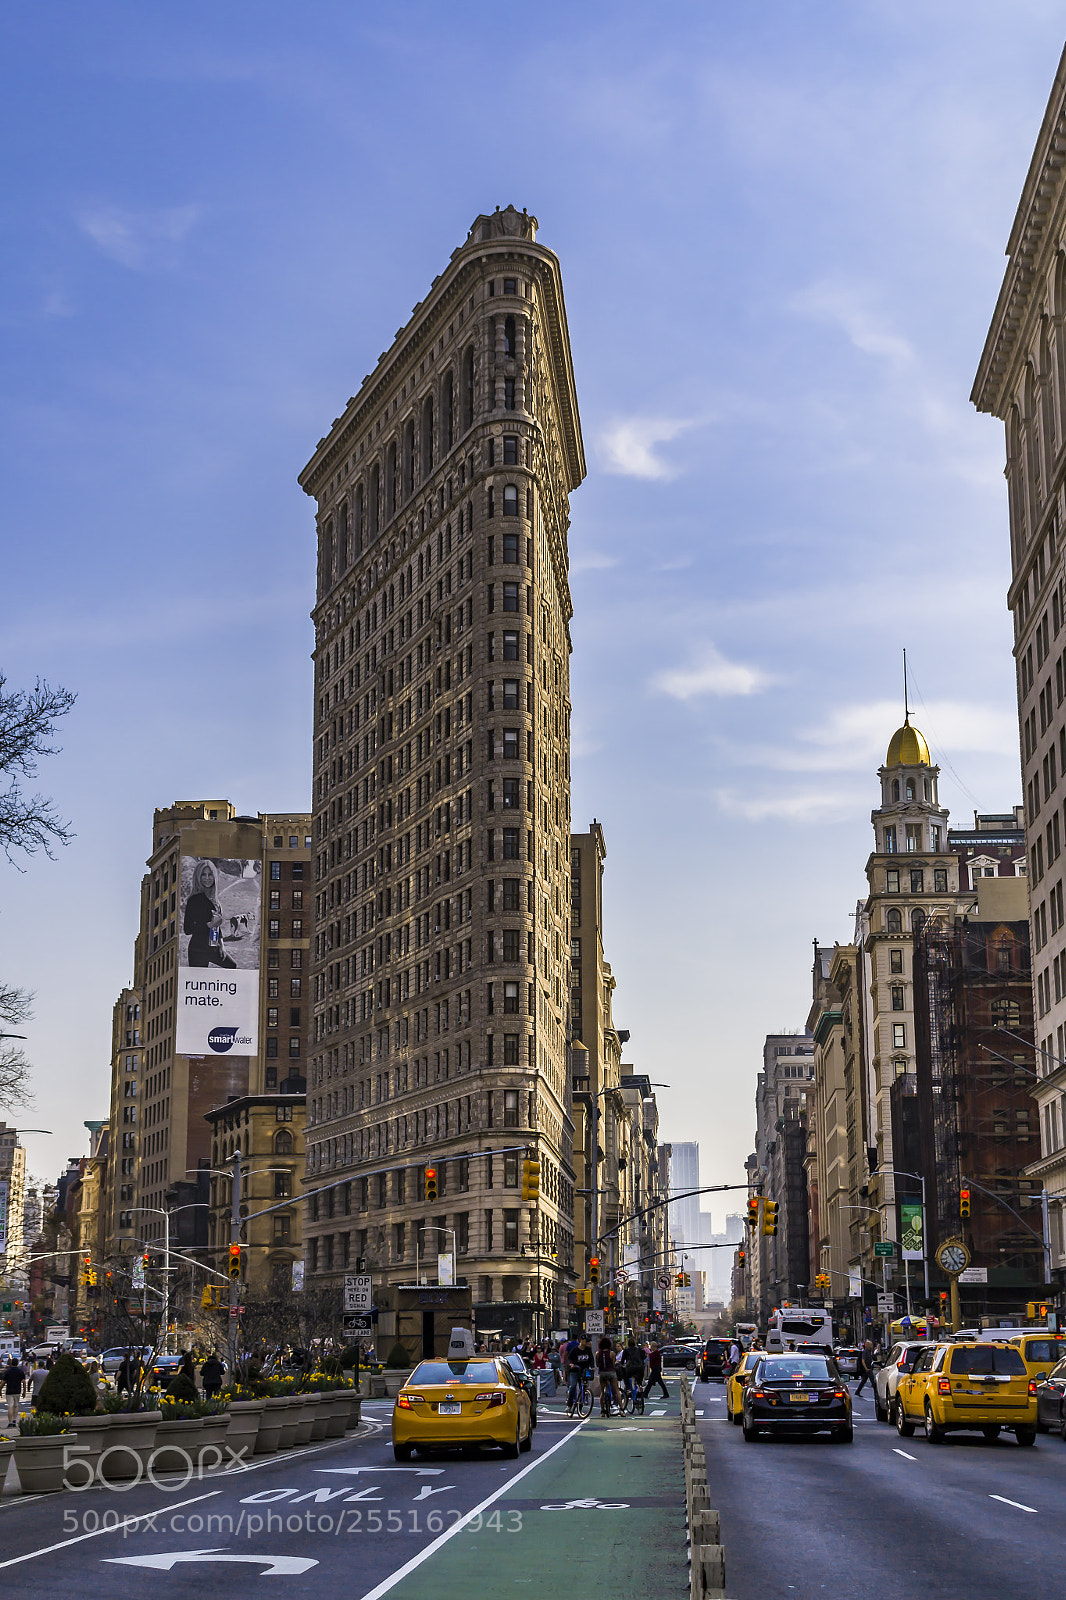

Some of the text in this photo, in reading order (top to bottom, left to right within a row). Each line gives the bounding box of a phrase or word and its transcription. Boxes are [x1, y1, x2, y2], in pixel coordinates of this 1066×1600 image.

[185, 979, 237, 995] running
[185, 994, 223, 1006] mate.
[346, 1277, 370, 1286] STOP
[349, 1294, 367, 1302] RED
[239, 1485, 457, 1503] ONLY
